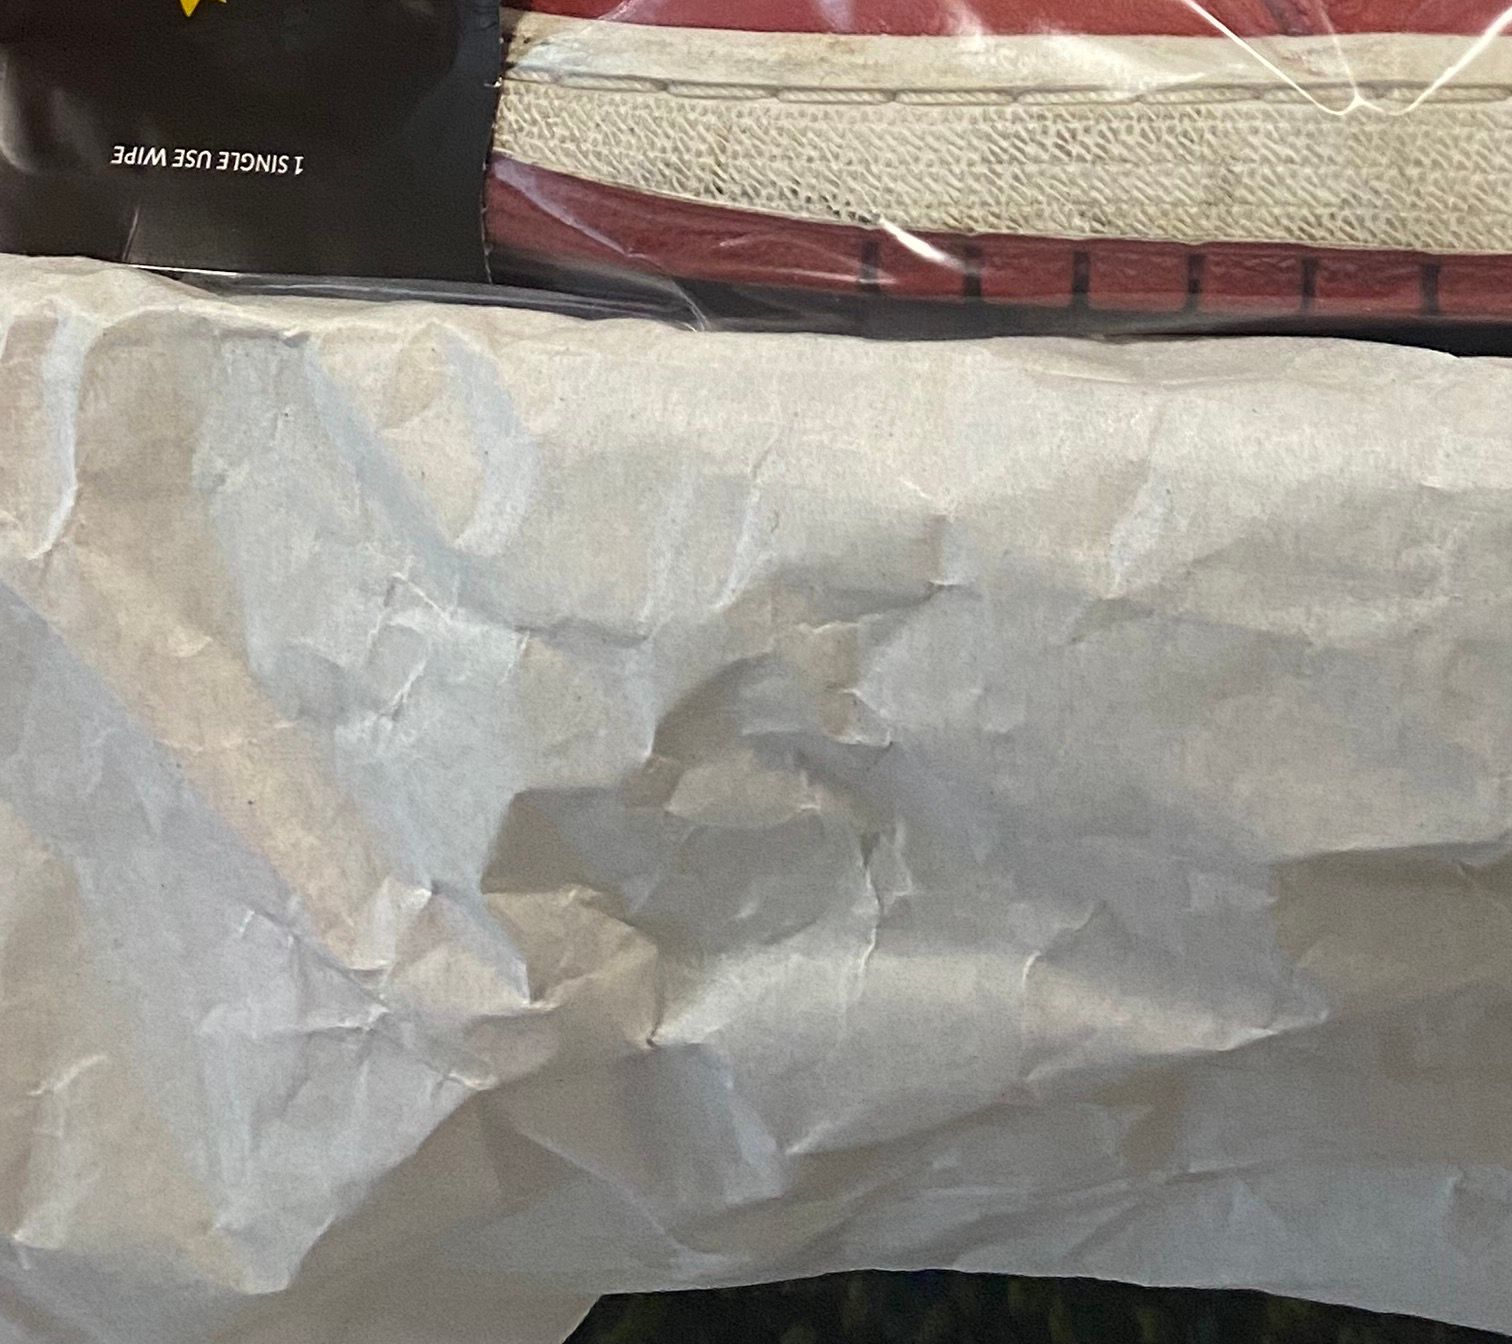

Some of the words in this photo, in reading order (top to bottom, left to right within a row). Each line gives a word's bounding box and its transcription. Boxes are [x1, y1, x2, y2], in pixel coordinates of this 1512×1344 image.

[109, 144, 167, 167] WIPE
[171, 148, 212, 169] USE
[215, 150, 290, 174] SINGLE
[293, 155, 305, 176] 1
